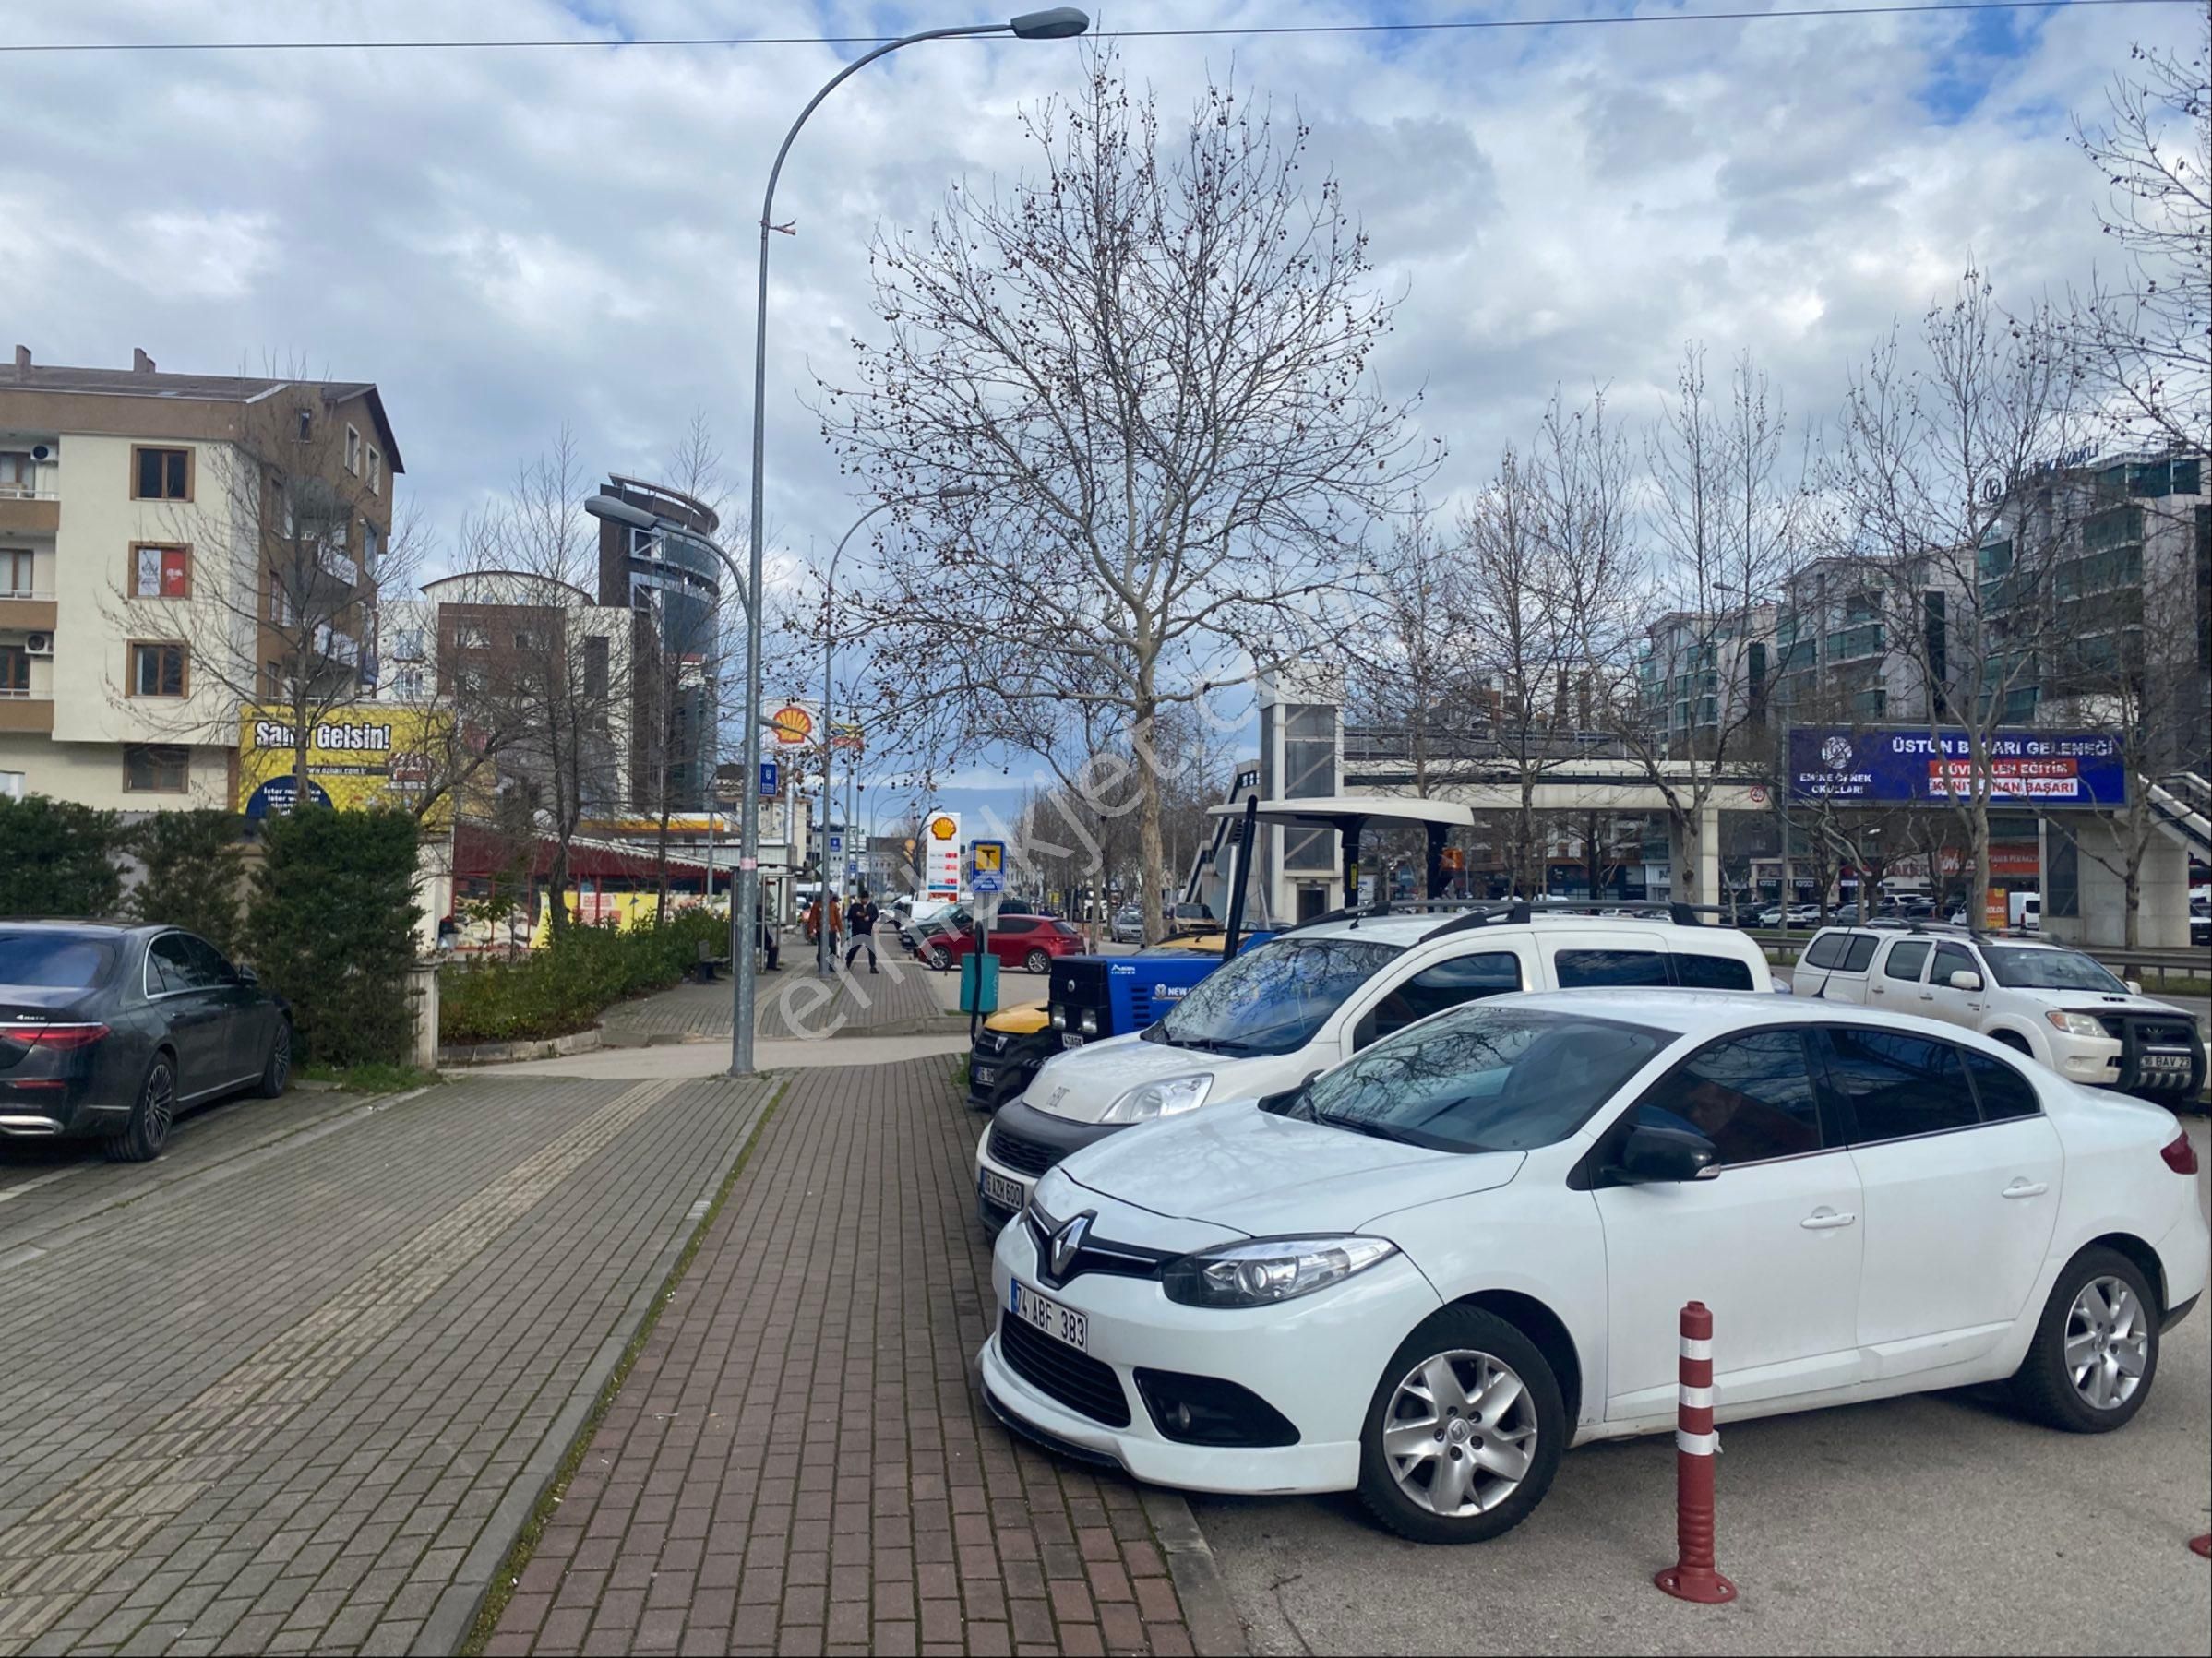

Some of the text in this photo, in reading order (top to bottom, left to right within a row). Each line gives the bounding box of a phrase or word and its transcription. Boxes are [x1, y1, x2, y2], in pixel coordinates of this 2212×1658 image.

[316, 722, 392, 750] Gelsin!
[981, 849, 996, 866] T
[1167, 986, 1188, 996] NEW
[2156, 1056, 2176, 1067] BAV
[1033, 1294, 1052, 1330] ABF
[1060, 1309, 1085, 1347] 383
